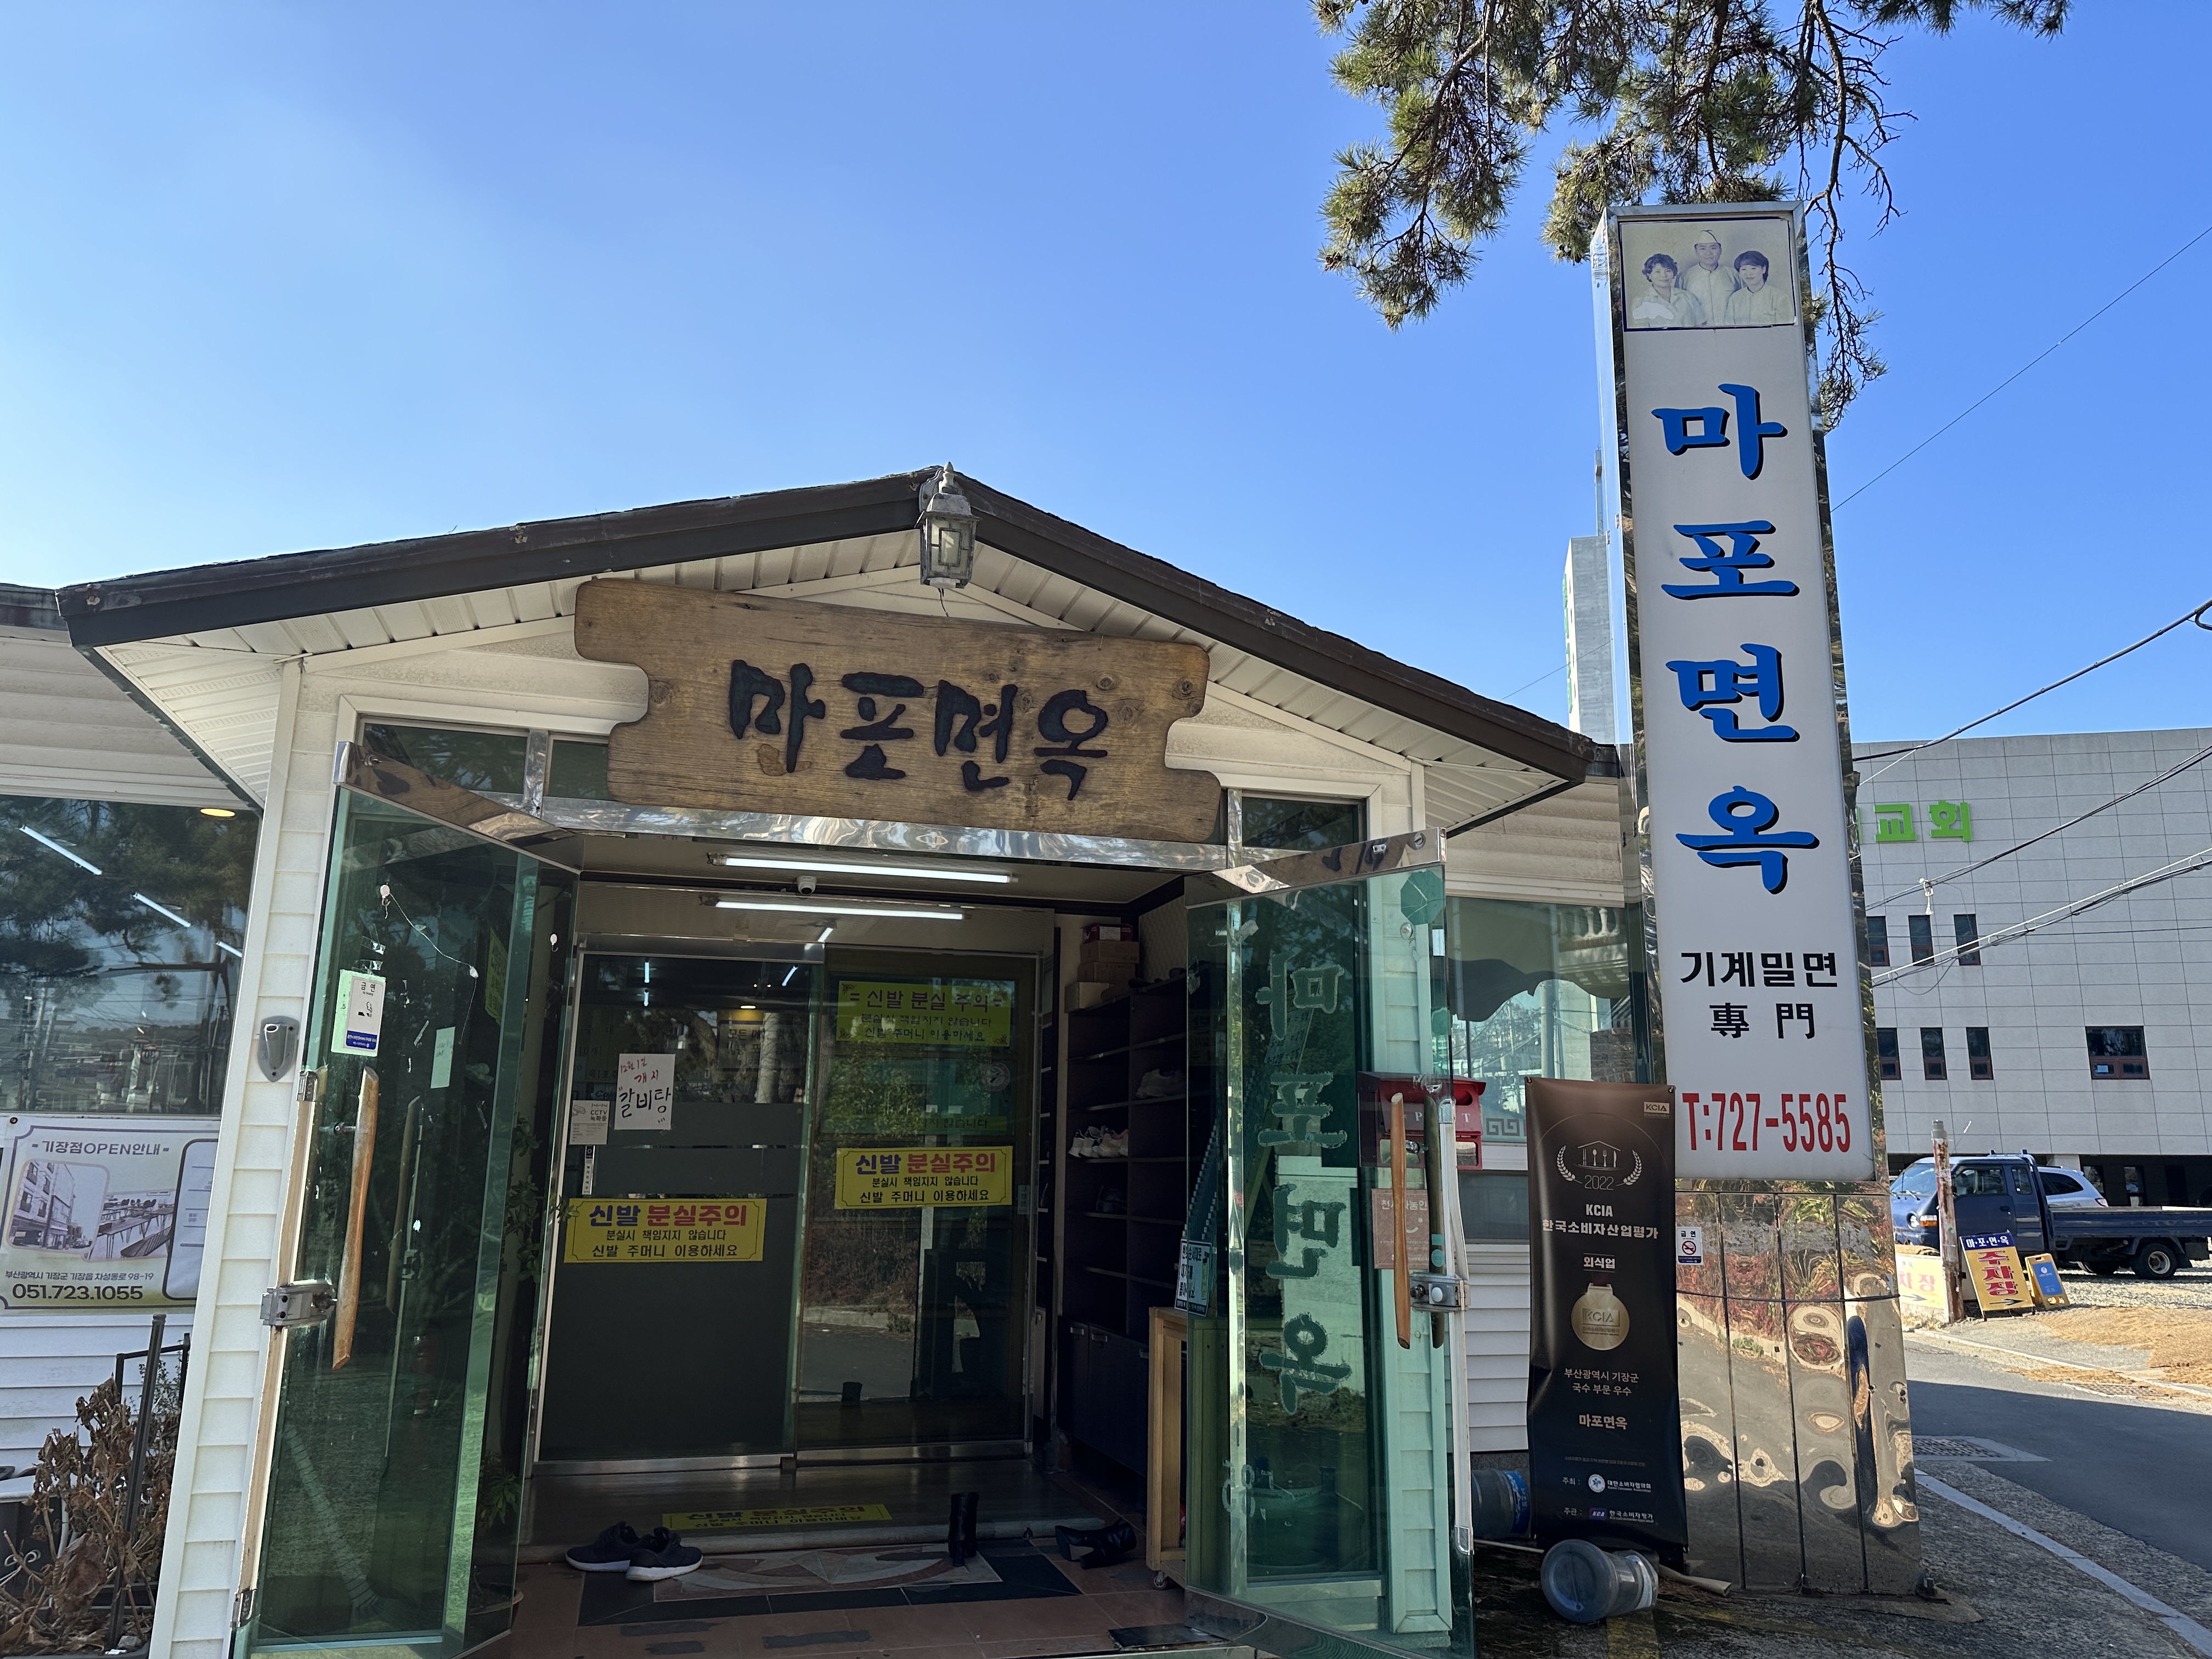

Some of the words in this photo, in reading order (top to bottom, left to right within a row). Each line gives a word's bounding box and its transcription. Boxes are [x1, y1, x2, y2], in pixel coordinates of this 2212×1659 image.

[1651, 383, 1820, 894] 마포면옥
[729, 659, 1108, 800] 마포면옥
[1856, 800, 1973, 844] 교회
[1680, 952, 1837, 988] 기계밀면
[867, 990, 904, 1009] 신발
[911, 992, 946, 1011] 분실
[955, 994, 989, 1012] 주의
[861, 1013, 895, 1025] 분실시
[899, 1015, 943, 1026] 책임지지
[947, 1016, 991, 1026] 않습니다
[1709, 1002, 1815, 1039] 專門
[866, 1027, 886, 1038] 신발
[895, 1028, 924, 1040] 주머니
[931, 1029, 985, 1041] 이용하세요
[619, 1087, 672, 1118] 갈비탕
[1646, 1104, 1667, 1112] KCIA
[1682, 1093, 1850, 1152] T:727-5585
[42, 1141, 161, 1155] 기장점OPEN안내
[856, 1154, 901, 1175] 신발
[907, 1153, 995, 1173] 분실주의
[872, 1177, 898, 1188] 분실시
[904, 1176, 938, 1187] 책임지지
[945, 1176, 978, 1187] 않습니다
[1584, 1175, 1614, 1190] 2022
[860, 1191, 883, 1203] 신발
[891, 1191, 925, 1203] 주머니
[933, 1189, 989, 1201] 이용하세요
[589, 1205, 641, 1227] 신발
[647, 1204, 747, 1227] 분실주의
[1585, 1204, 1613, 1217] KCIA
[606, 1230, 635, 1241] 분실시
[642, 1230, 681, 1241] 책임지지
[688, 1229, 726, 1241] 않습니다
[1542, 1219, 1658, 1239] 한국소비자산업평가
[592, 1245, 618, 1257] 신발
[628, 1245, 665, 1257] 주머니
[675, 1244, 737, 1257] 이용하세요
[1583, 1256, 1615, 1269] 외식업
[5, 1271, 43, 1279] 부산광역시
[44, 1272, 68, 1280] 기장군
[71, 1272, 93, 1280] 기장읍
[128, 1272, 154, 1280] 98-19
[1977, 1250, 2018, 1296] 주차장
[13, 1284, 143, 1300] 051.723.1055
[1584, 1311, 1613, 1323] KCIA
[1564, 1368, 1610, 1381] 부산광역시
[1612, 1372, 1639, 1383] 기장군
[1572, 1383, 1590, 1393] 국수
[1593, 1384, 1611, 1395] 부문
[1613, 1385, 1632, 1396] 우수
[1579, 1414, 1627, 1430] 마포면옥
[1562, 1477, 1576, 1486] 주최
[1564, 1507, 1577, 1516] 주관
